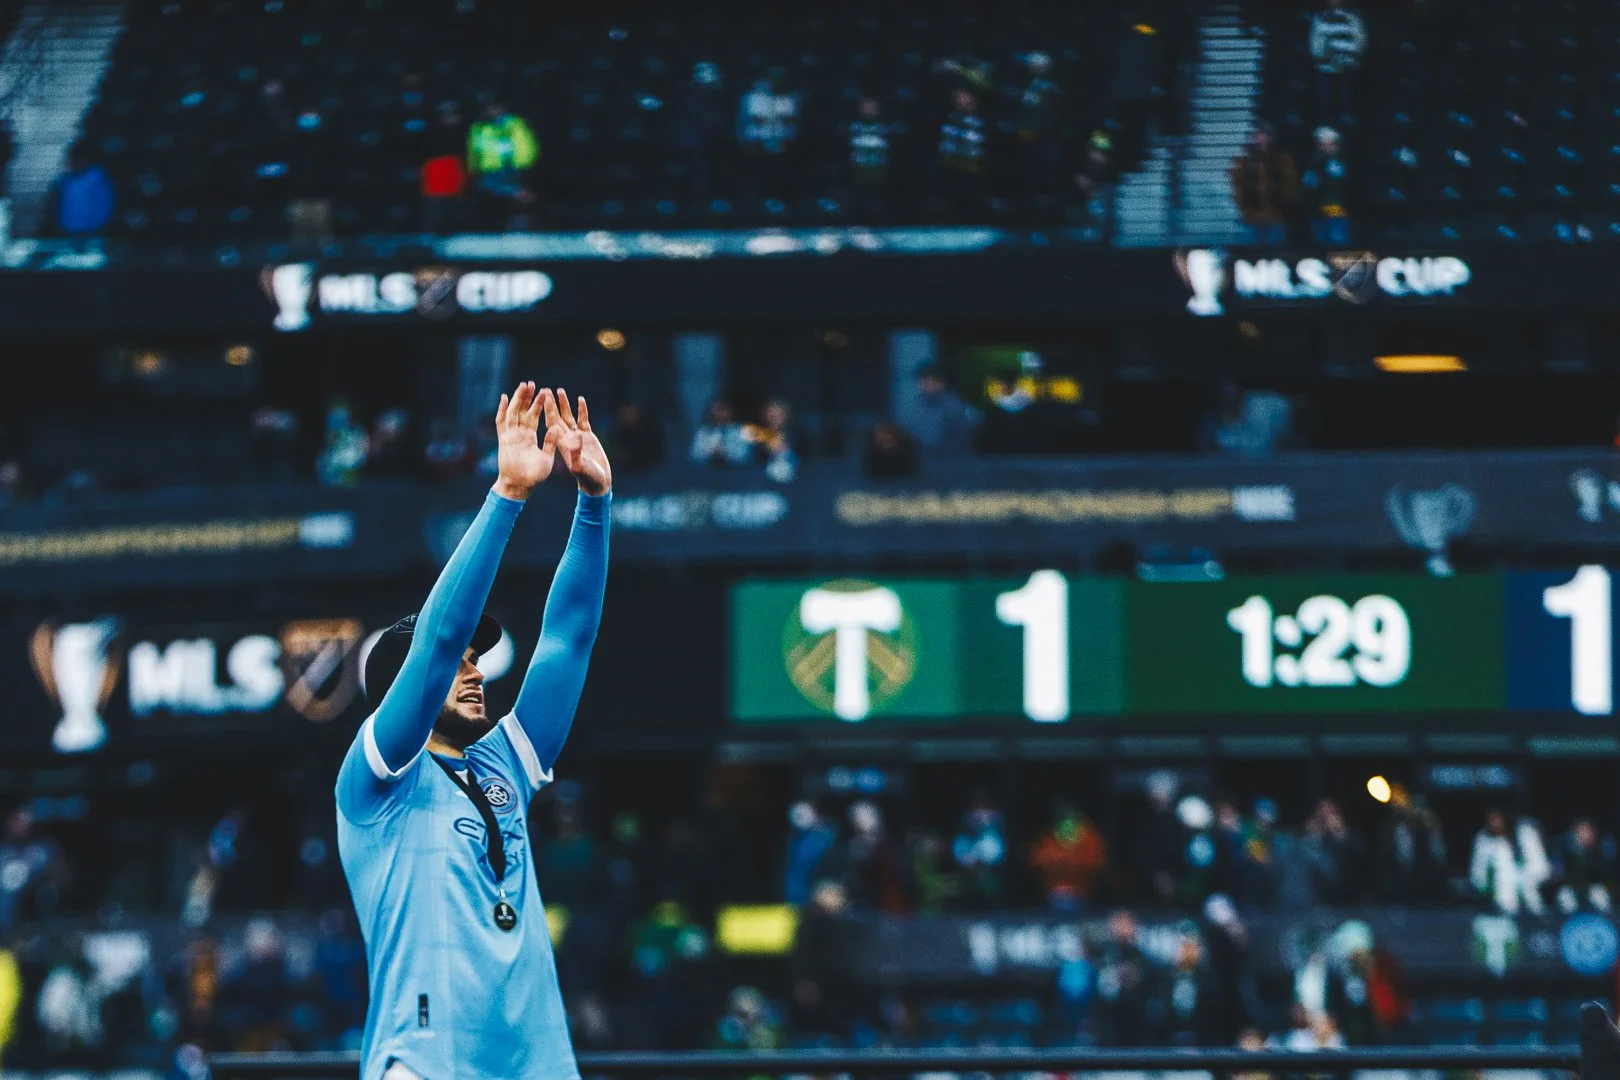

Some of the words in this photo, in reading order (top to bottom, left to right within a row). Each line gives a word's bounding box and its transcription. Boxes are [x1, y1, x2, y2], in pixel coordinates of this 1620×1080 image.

[318, 272, 417, 312] MLS
[456, 271, 552, 310] CUP
[1233, 258, 1332, 297] MLS
[1376, 256, 1470, 295] CUP
[995, 569, 1070, 722] 1
[1227, 594, 1411, 687] 1:29
[1543, 564, 1613, 715] 1
[128, 635, 285, 711] MLS
